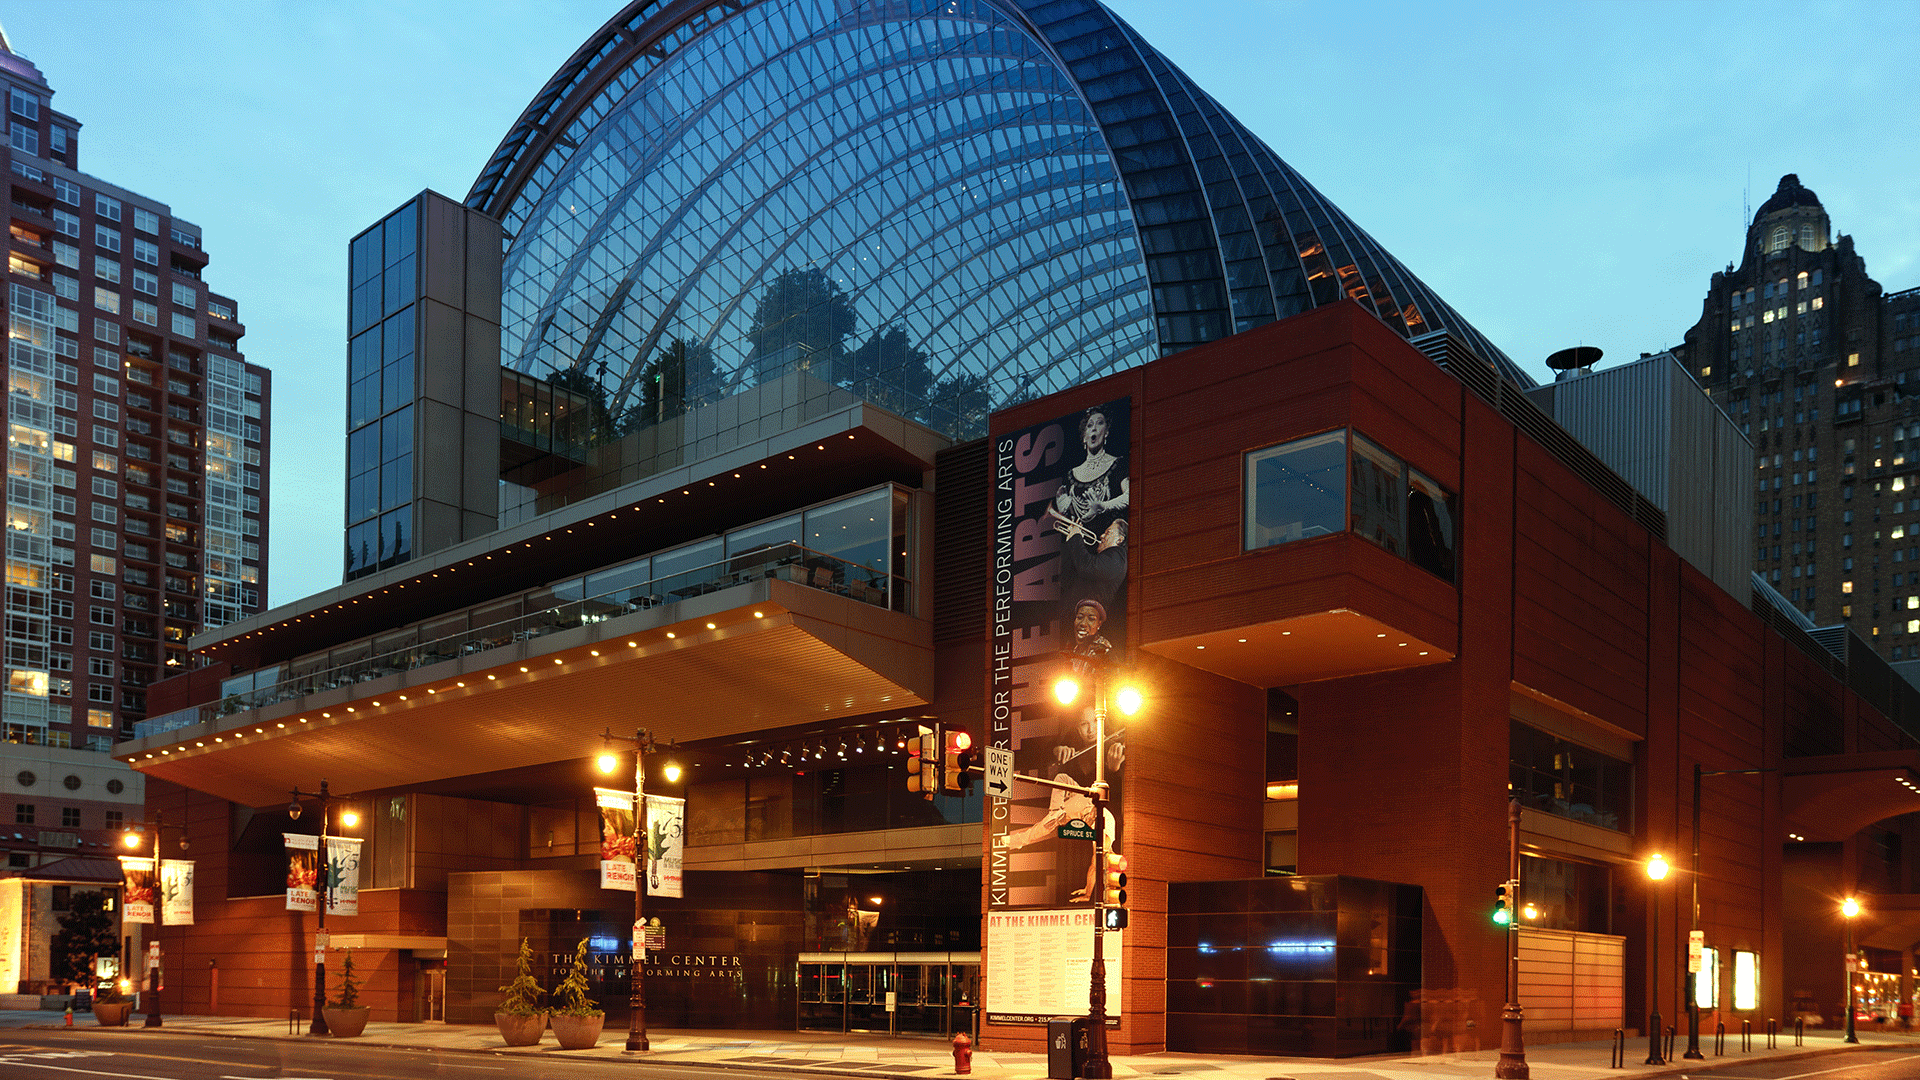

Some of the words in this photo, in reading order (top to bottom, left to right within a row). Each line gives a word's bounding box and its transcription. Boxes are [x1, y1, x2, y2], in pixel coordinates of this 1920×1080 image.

[998, 438, 1014, 492] ARTS
[1013, 423, 1065, 602] ARTS
[996, 499, 1012, 637] PERFORMING
[995, 642, 1010, 685] THE
[1011, 620, 1063, 751] THE
[994, 690, 1010, 732] FOR
[989, 765, 1009, 778] WAY
[990, 752, 1008, 766] ONE
[993, 739, 1009, 820] CER
[1063, 829, 1084, 838] SPRUCE
[605, 863, 627, 871] LATE
[992, 825, 1008, 905] KIMMEL
[290, 890, 309, 898] LATE
[989, 915, 1001, 928] AT
[1005, 915, 1025, 928] THE
[1028, 914, 1071, 927] KIMMEL
[1074, 913, 1096, 926] CEN
[553, 954, 573, 964] TH
[671, 955, 742, 967] CENTER
[615, 968, 701, 977] PEORMING
[709, 970, 742, 978] ARTS
